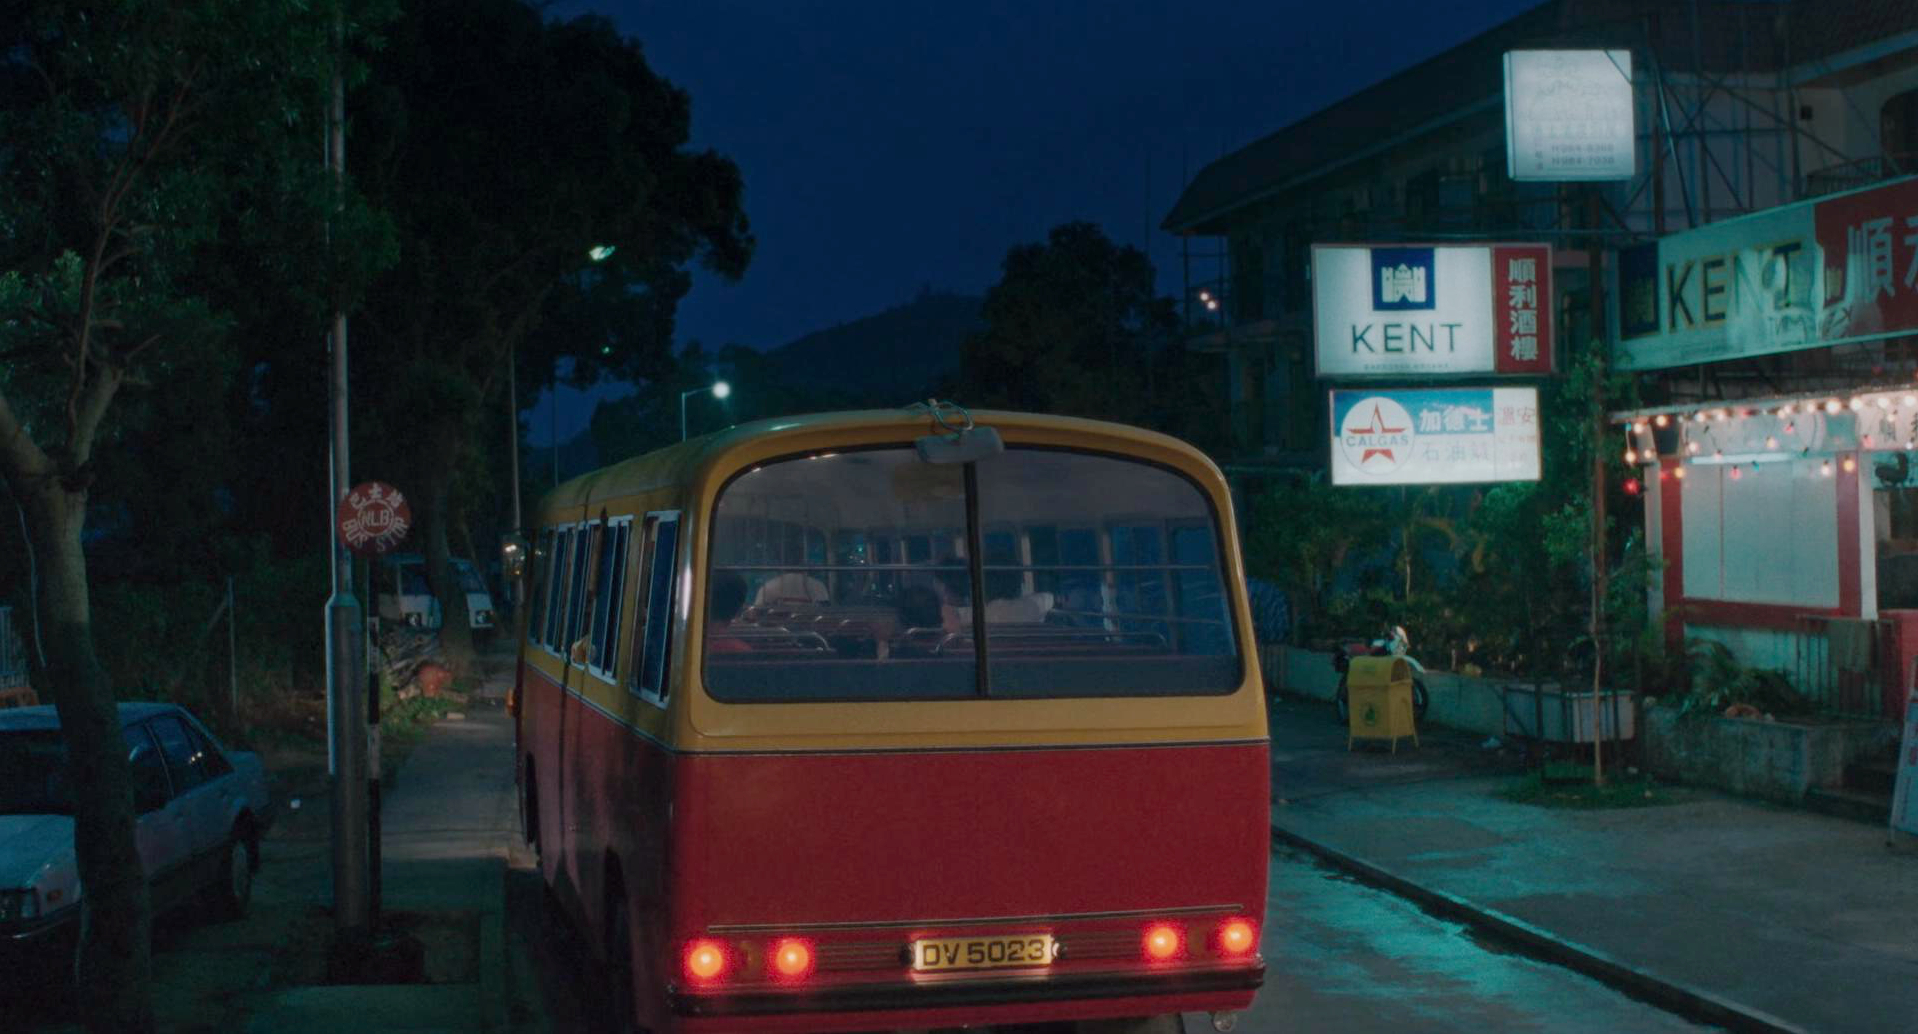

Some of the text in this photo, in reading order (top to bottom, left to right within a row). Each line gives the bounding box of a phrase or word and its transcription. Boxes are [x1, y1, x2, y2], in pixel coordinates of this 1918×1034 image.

[1508, 258, 1539, 362] 順利酒樓
[1350, 322, 1463, 354] KENT
[1419, 405, 1492, 432] 加德士
[1345, 434, 1409, 447] CALGAS
[361, 510, 391, 527] NLB
[343, 516, 409, 553] BUS STOP
[923, 940, 1045, 966] DV 5023
